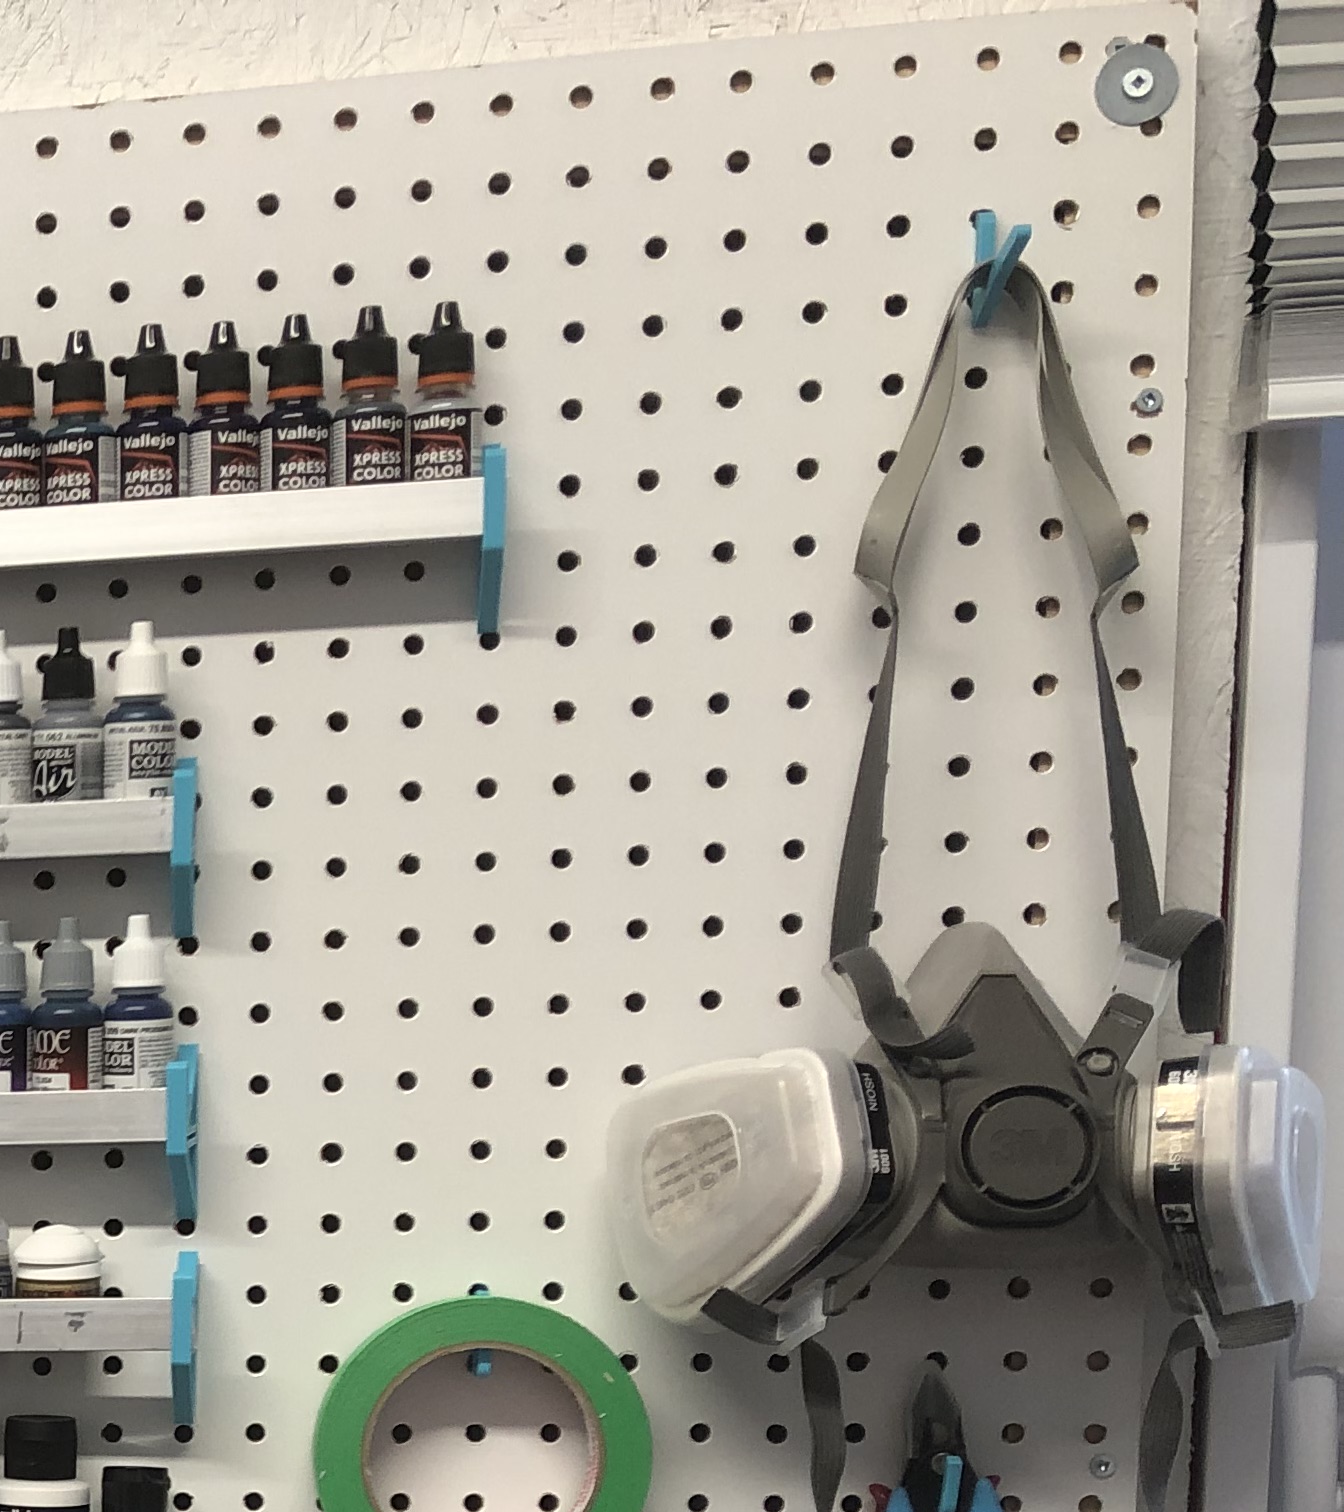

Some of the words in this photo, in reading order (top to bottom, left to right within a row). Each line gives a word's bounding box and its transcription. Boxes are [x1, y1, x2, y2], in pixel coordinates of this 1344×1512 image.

[352, 416, 403, 432] Vallejo
[414, 414, 465, 430] Vallejo
[124, 433, 175, 450] Vallejo
[278, 426, 329, 442] Vallejo
[354, 451, 401, 467] XPRESS
[415, 450, 463, 465] XPRESS
[126, 468, 173, 482] XPRESS
[279, 461, 326, 475] XPRESS
[354, 466, 401, 481] COLOR
[125, 483, 173, 498] COLOR
[279, 476, 327, 490] COLOR
[862, 1073, 878, 1111] NIOSH
